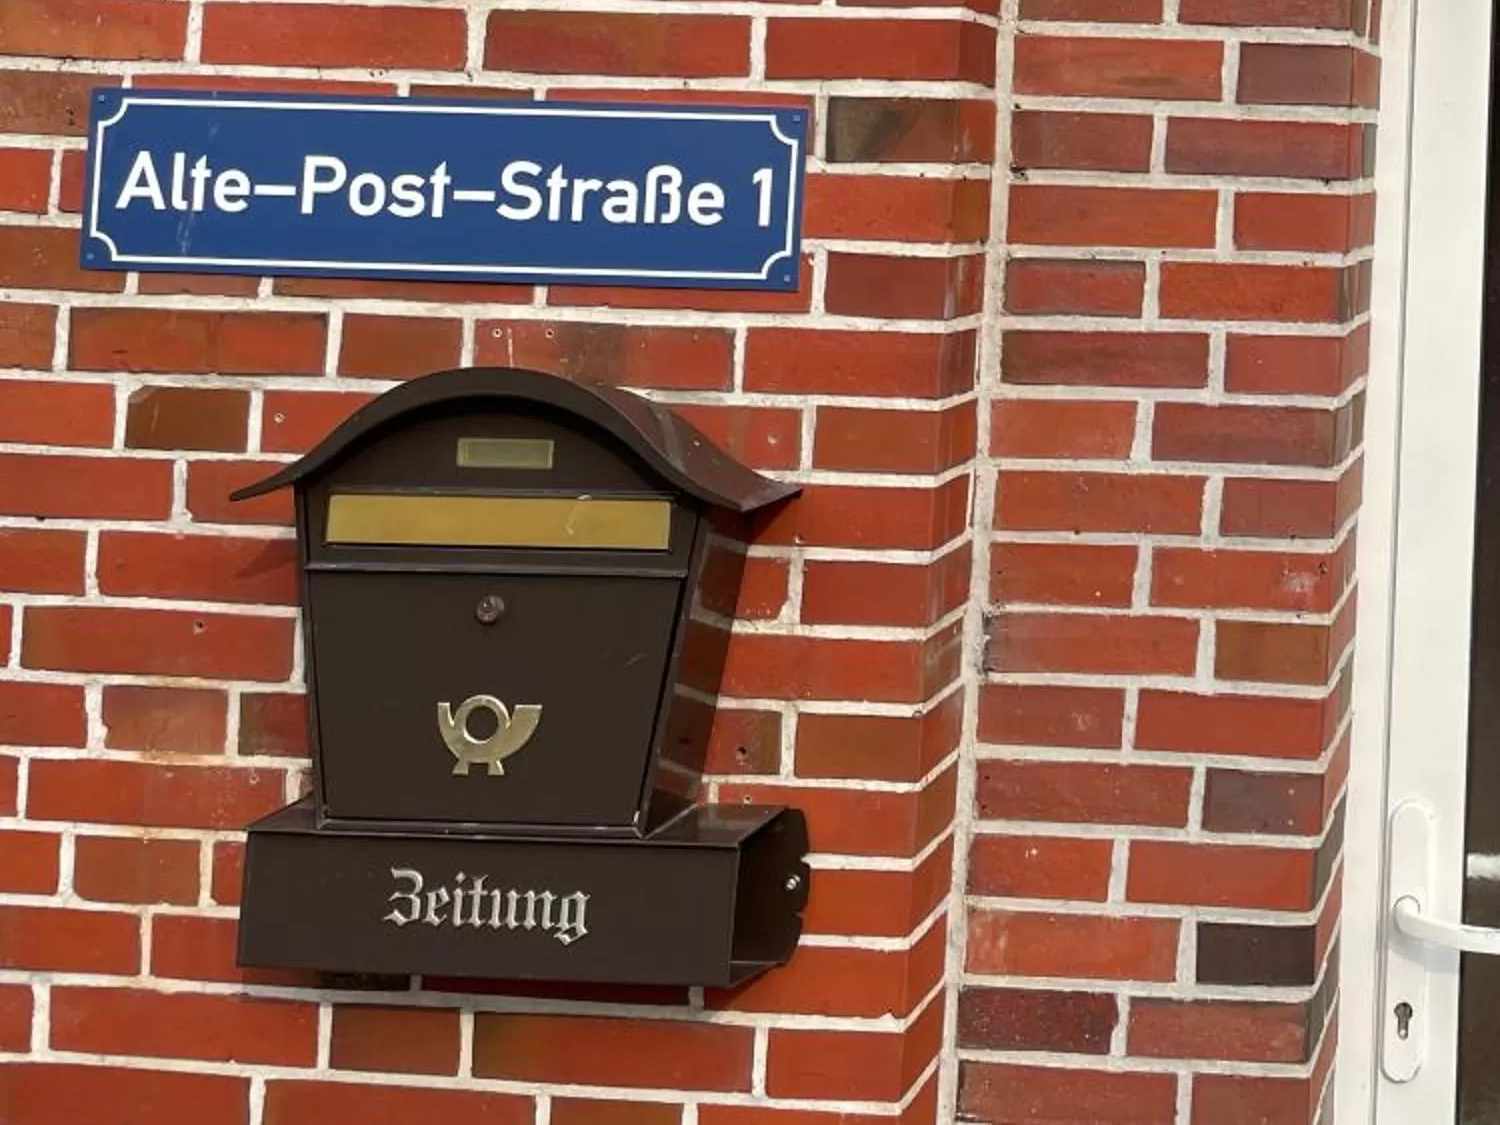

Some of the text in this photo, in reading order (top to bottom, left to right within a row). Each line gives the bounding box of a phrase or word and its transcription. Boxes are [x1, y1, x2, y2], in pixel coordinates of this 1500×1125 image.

[114, 150, 773, 227] Alte-Post-Straße 1
[383, 866, 592, 947] Zeitung
